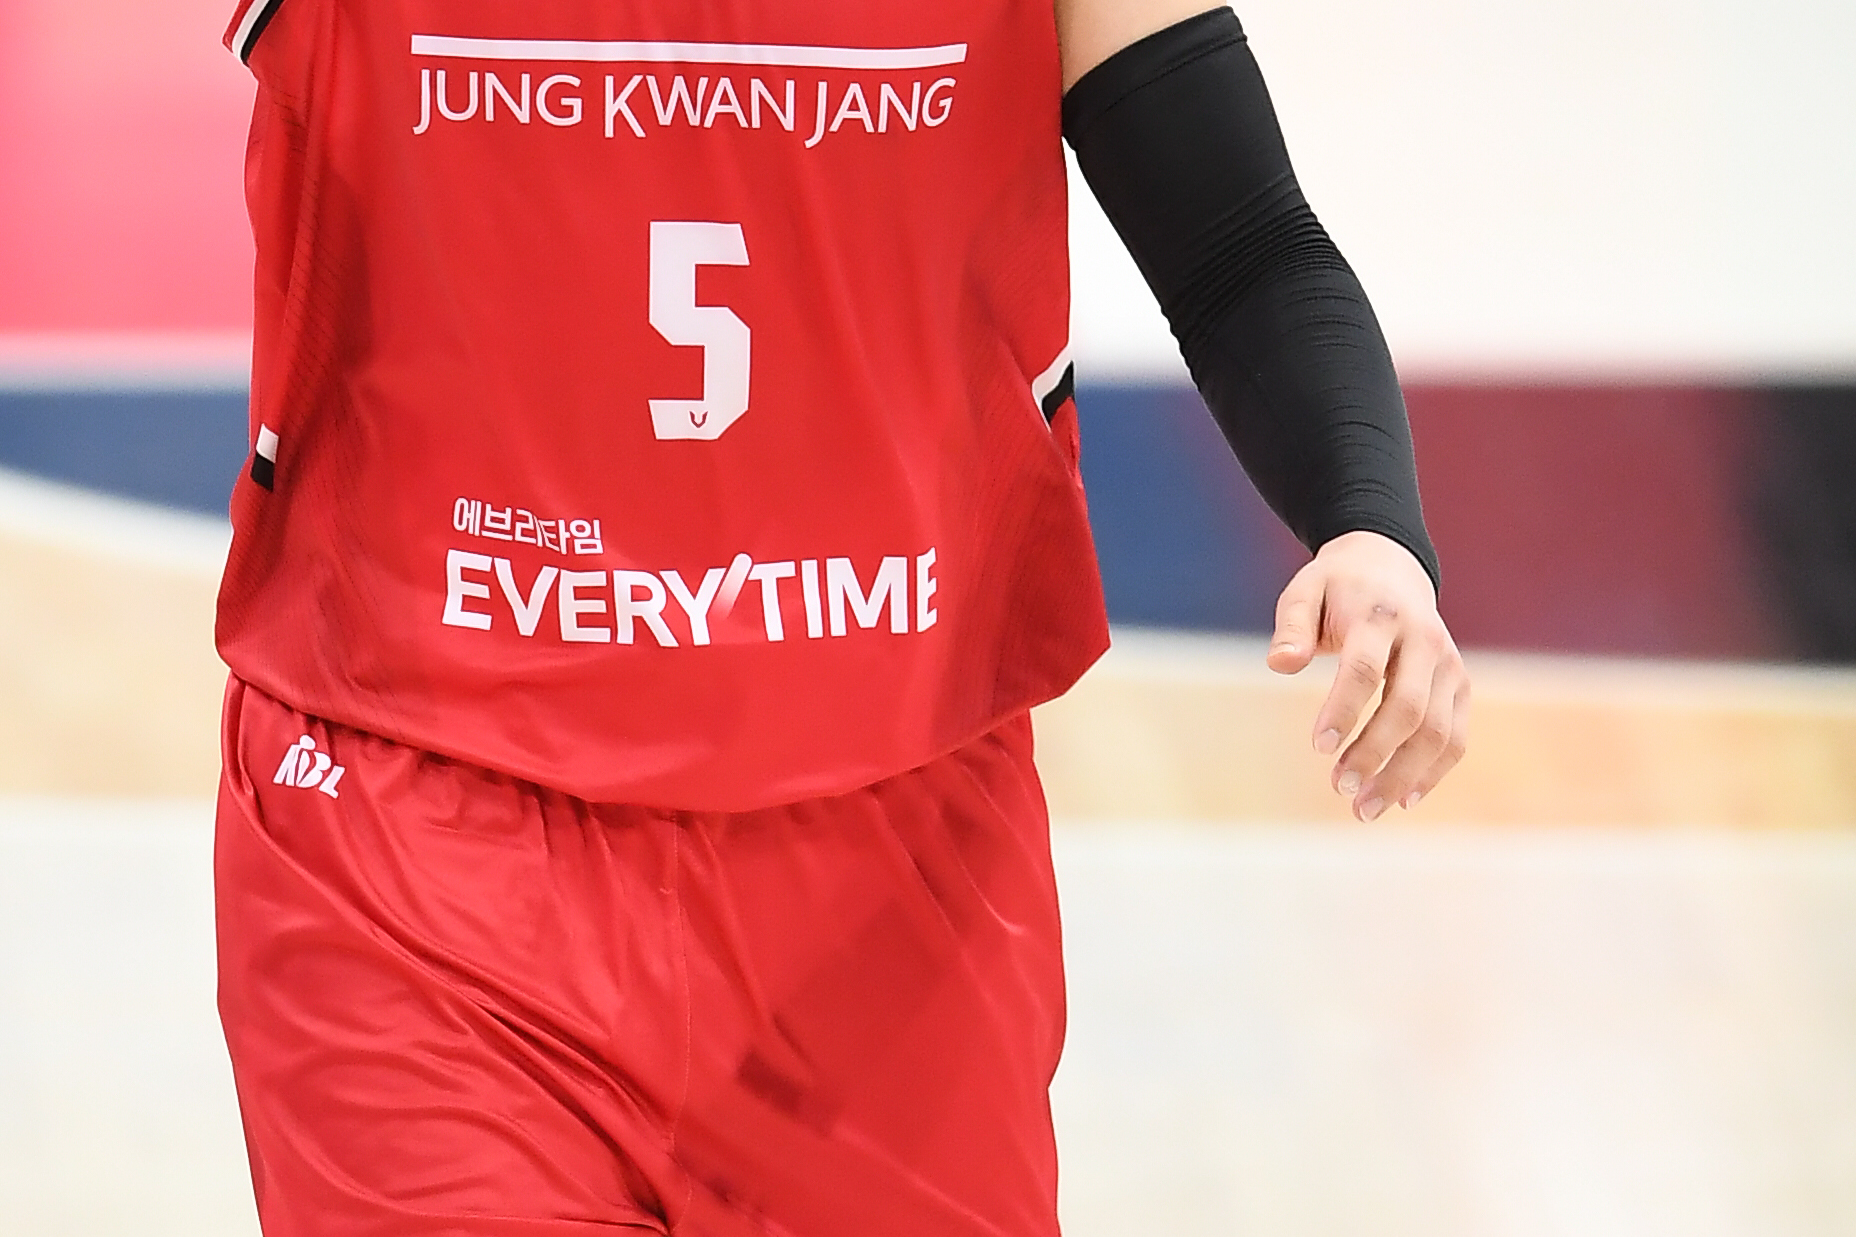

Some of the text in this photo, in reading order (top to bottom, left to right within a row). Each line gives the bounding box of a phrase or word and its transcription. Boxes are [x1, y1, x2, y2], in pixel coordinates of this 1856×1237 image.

[412, 68, 957, 149] JUNG KWAN JANG
[647, 221, 751, 441] 5
[453, 497, 604, 555] 에브리타임
[272, 734, 346, 799] KBL
